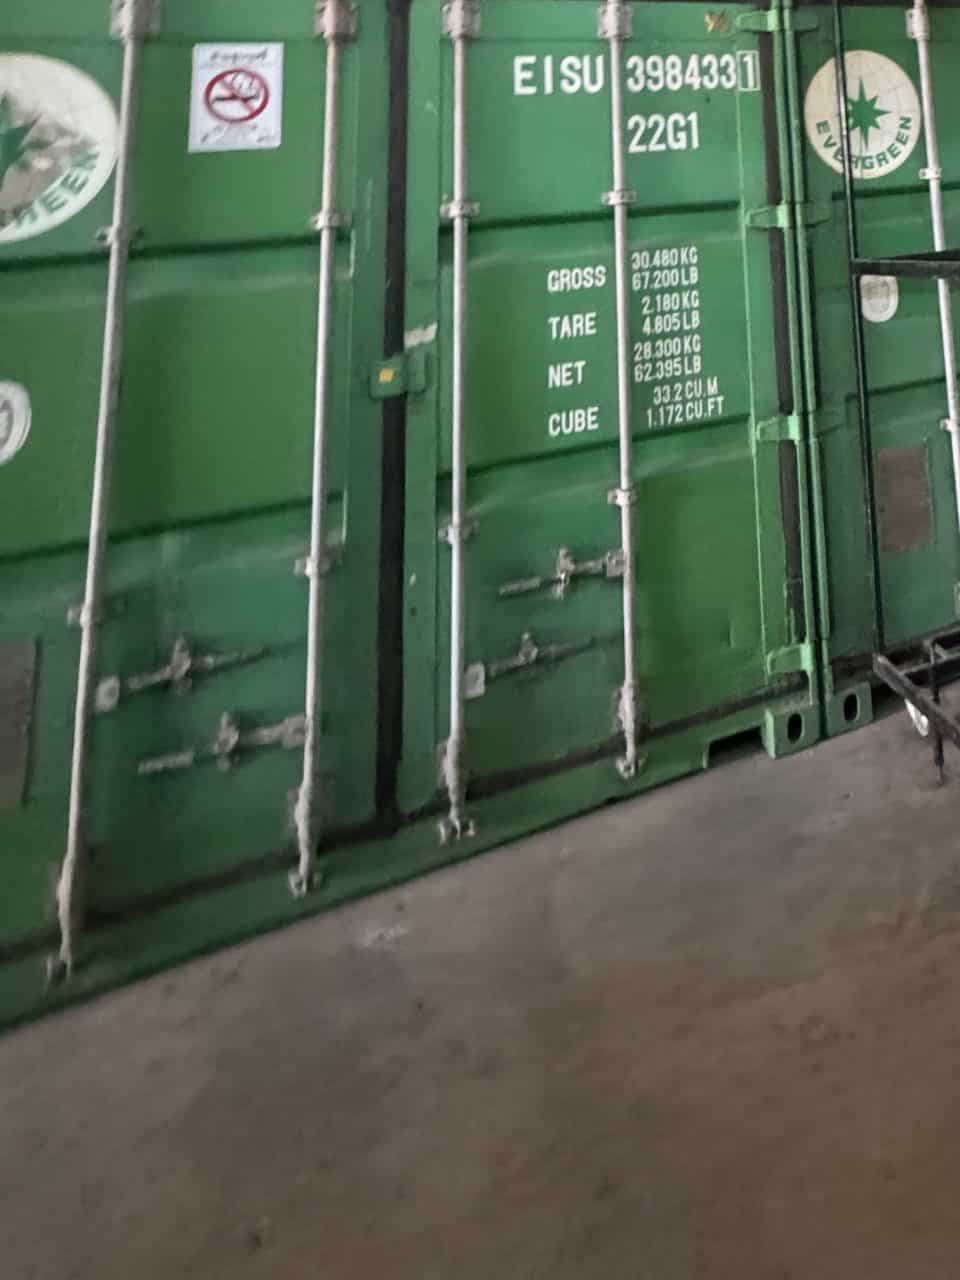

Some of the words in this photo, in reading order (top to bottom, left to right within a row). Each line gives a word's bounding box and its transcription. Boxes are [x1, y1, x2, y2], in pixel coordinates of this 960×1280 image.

[513, 53, 605, 96] EISU
[626, 50, 761, 93] 3984331
[627, 111, 700, 154] 22G1
[547, 265, 607, 293] GROSS
[548, 312, 597, 340] TARE
[548, 360, 586, 389] NET
[548, 406, 599, 437] CUBE
